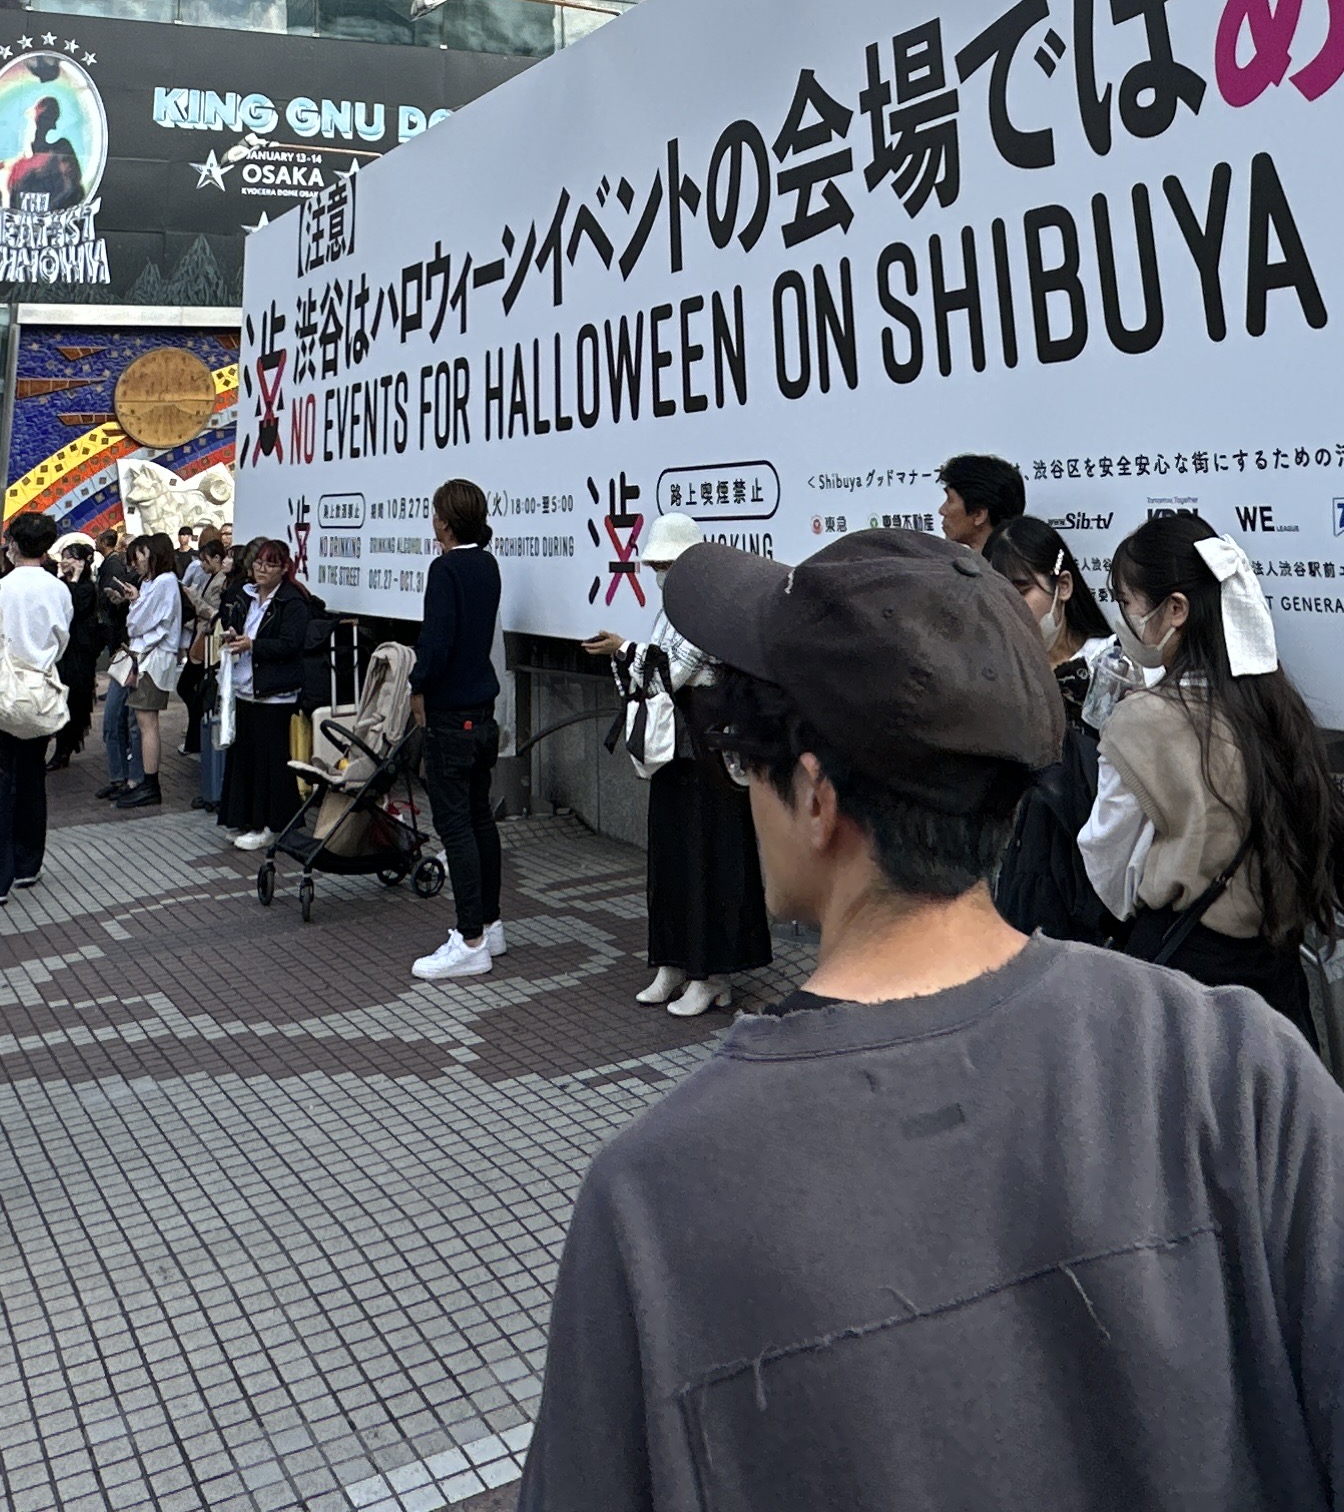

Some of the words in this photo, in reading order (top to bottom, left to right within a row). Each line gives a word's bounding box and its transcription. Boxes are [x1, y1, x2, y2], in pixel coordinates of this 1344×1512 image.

[153, 86, 278, 134] KING
[285, 97, 386, 141] GNU
[246, 150, 294, 163] JANUARY
[242, 164, 324, 187] OSAKA
[241, 187, 276, 197] KYOCERA
[277, 189, 298, 198] DOME
[290, 394, 316, 466] NO
[323, 372, 409, 462] EVENTS
[419, 355, 471, 449] FOR
[484, 284, 748, 443] HALLOWEEN
[772, 257, 859, 400] ON
[877, 152, 1328, 386] SHIBUYA
[671, 477, 764, 506] 路上喫煙禁止
[1174, 496, 1198, 504] Together
[825, 516, 847, 533] 東急
[1235, 505, 1275, 532] WE
[1276, 524, 1299, 532] LEAGUE
[330, 536, 361, 559] DRINKING
[495, 535, 540, 557] PROHIBITED
[542, 535, 574, 558] DURING
[339, 566, 360, 587] STREET
